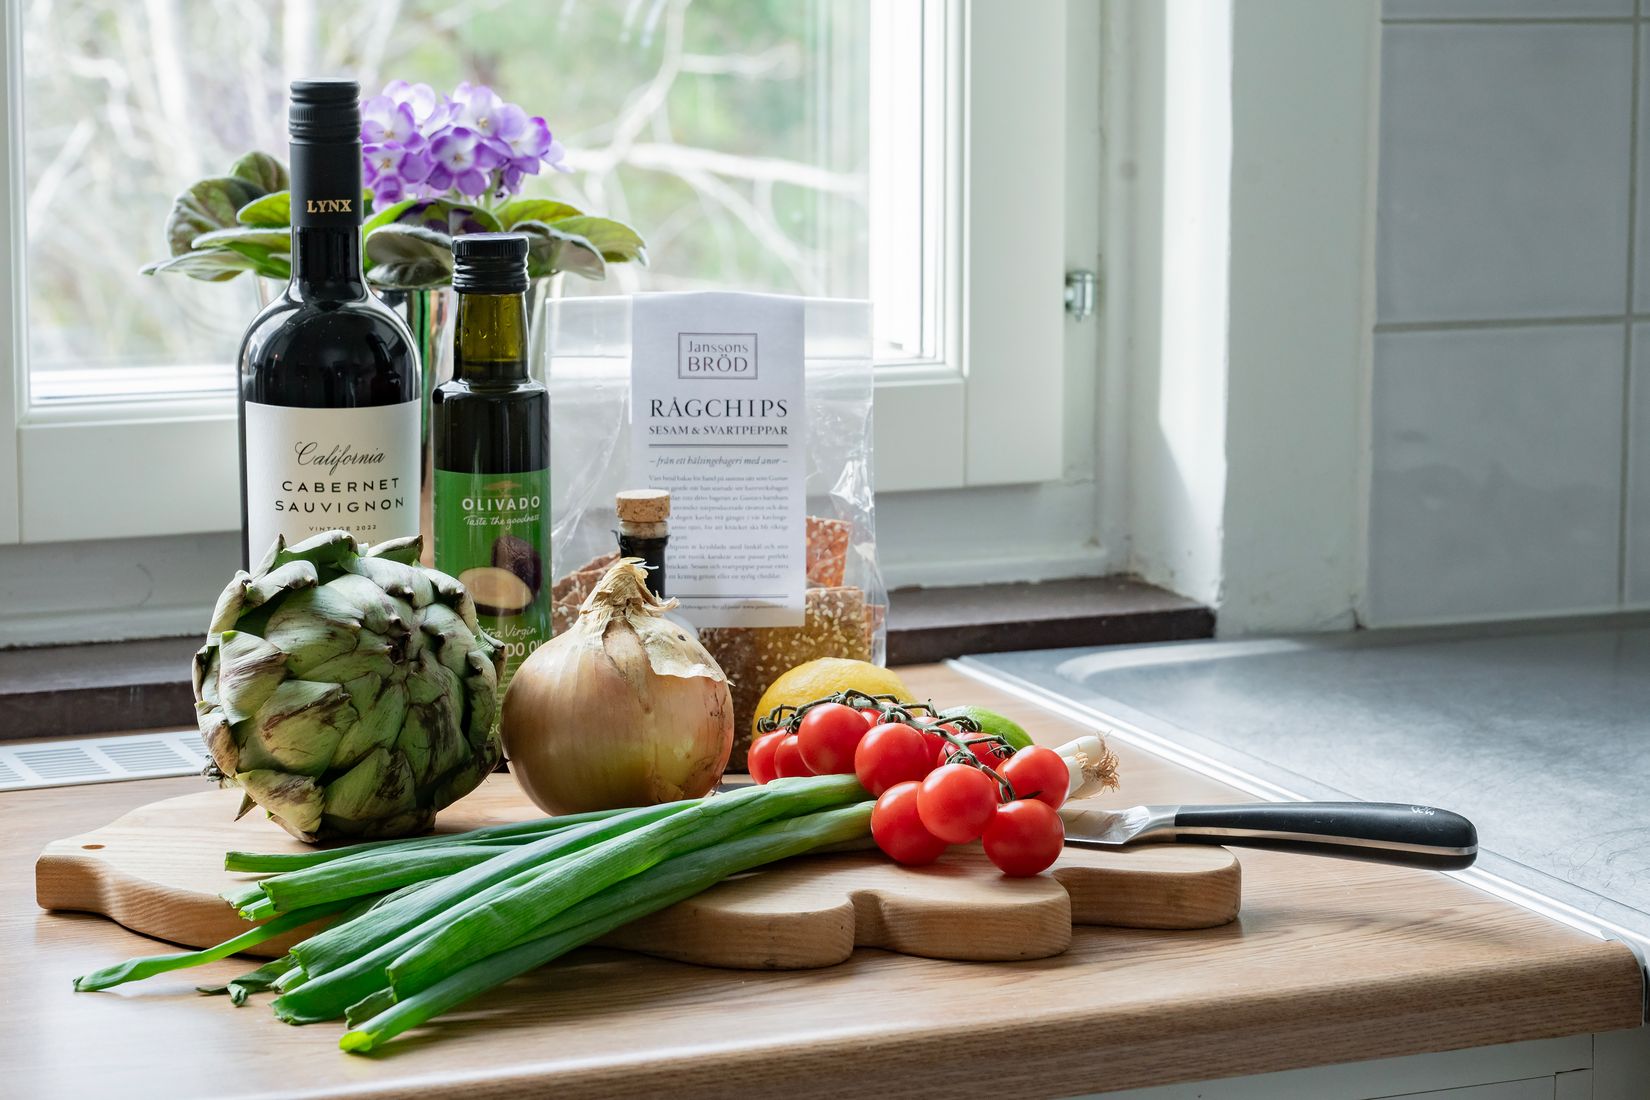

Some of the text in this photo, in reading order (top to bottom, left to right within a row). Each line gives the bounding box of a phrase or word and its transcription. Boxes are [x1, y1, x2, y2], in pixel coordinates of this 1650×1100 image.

[306, 199, 352, 213] LYNX
[688, 340, 749, 353] Janssons
[688, 354, 748, 372] BRÖD
[649, 396, 788, 418] RÅGCHIPS
[649, 425, 788, 435] SESAM & SVARTPEPPAR
[294, 441, 385, 476] California
[656, 455, 674, 468] från
[675, 456, 686, 465] ett
[744, 455, 761, 465] med
[282, 477, 400, 493] CABERNET
[275, 497, 404, 513] SAUVIGNON
[462, 496, 541, 511] OLIVADO
[464, 513, 540, 530] Taste the goodness
[505, 624, 537, 640] Virgin
